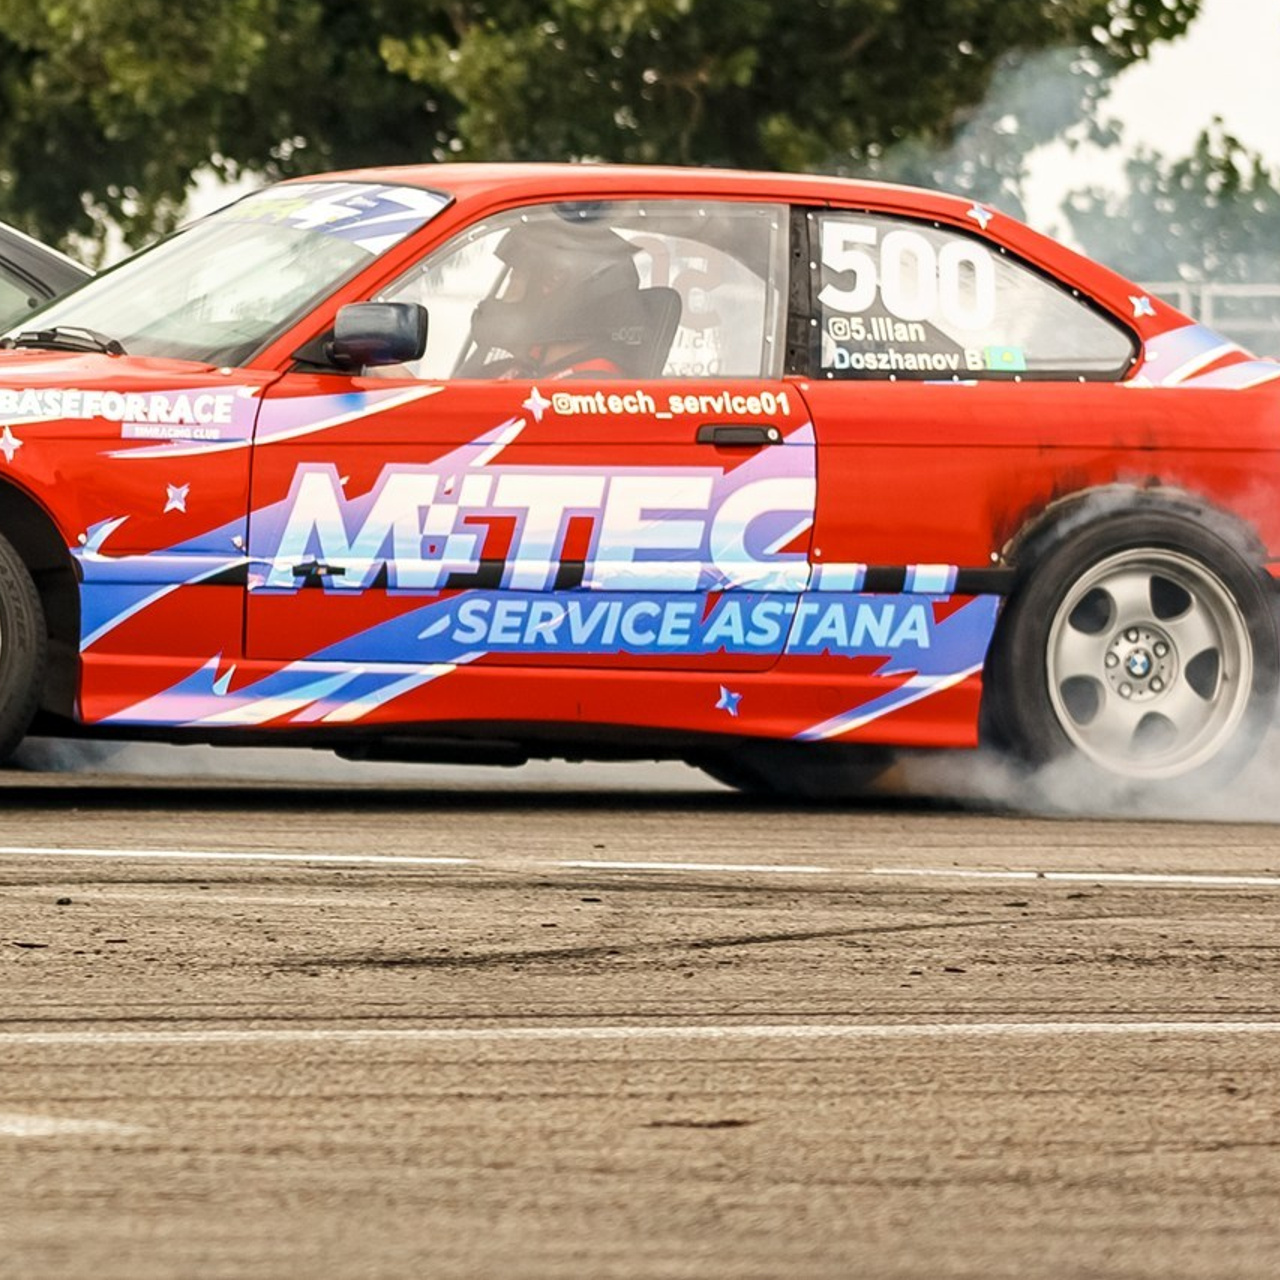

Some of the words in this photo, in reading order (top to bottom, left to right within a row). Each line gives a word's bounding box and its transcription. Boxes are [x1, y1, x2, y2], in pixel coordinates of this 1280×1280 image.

[818, 221, 996, 329] 500
[834, 347, 960, 370] Doszhanov
[964, 349, 984, 370] B
[452, 599, 697, 646] SERVICE
[703, 601, 930, 648] ASTANA
